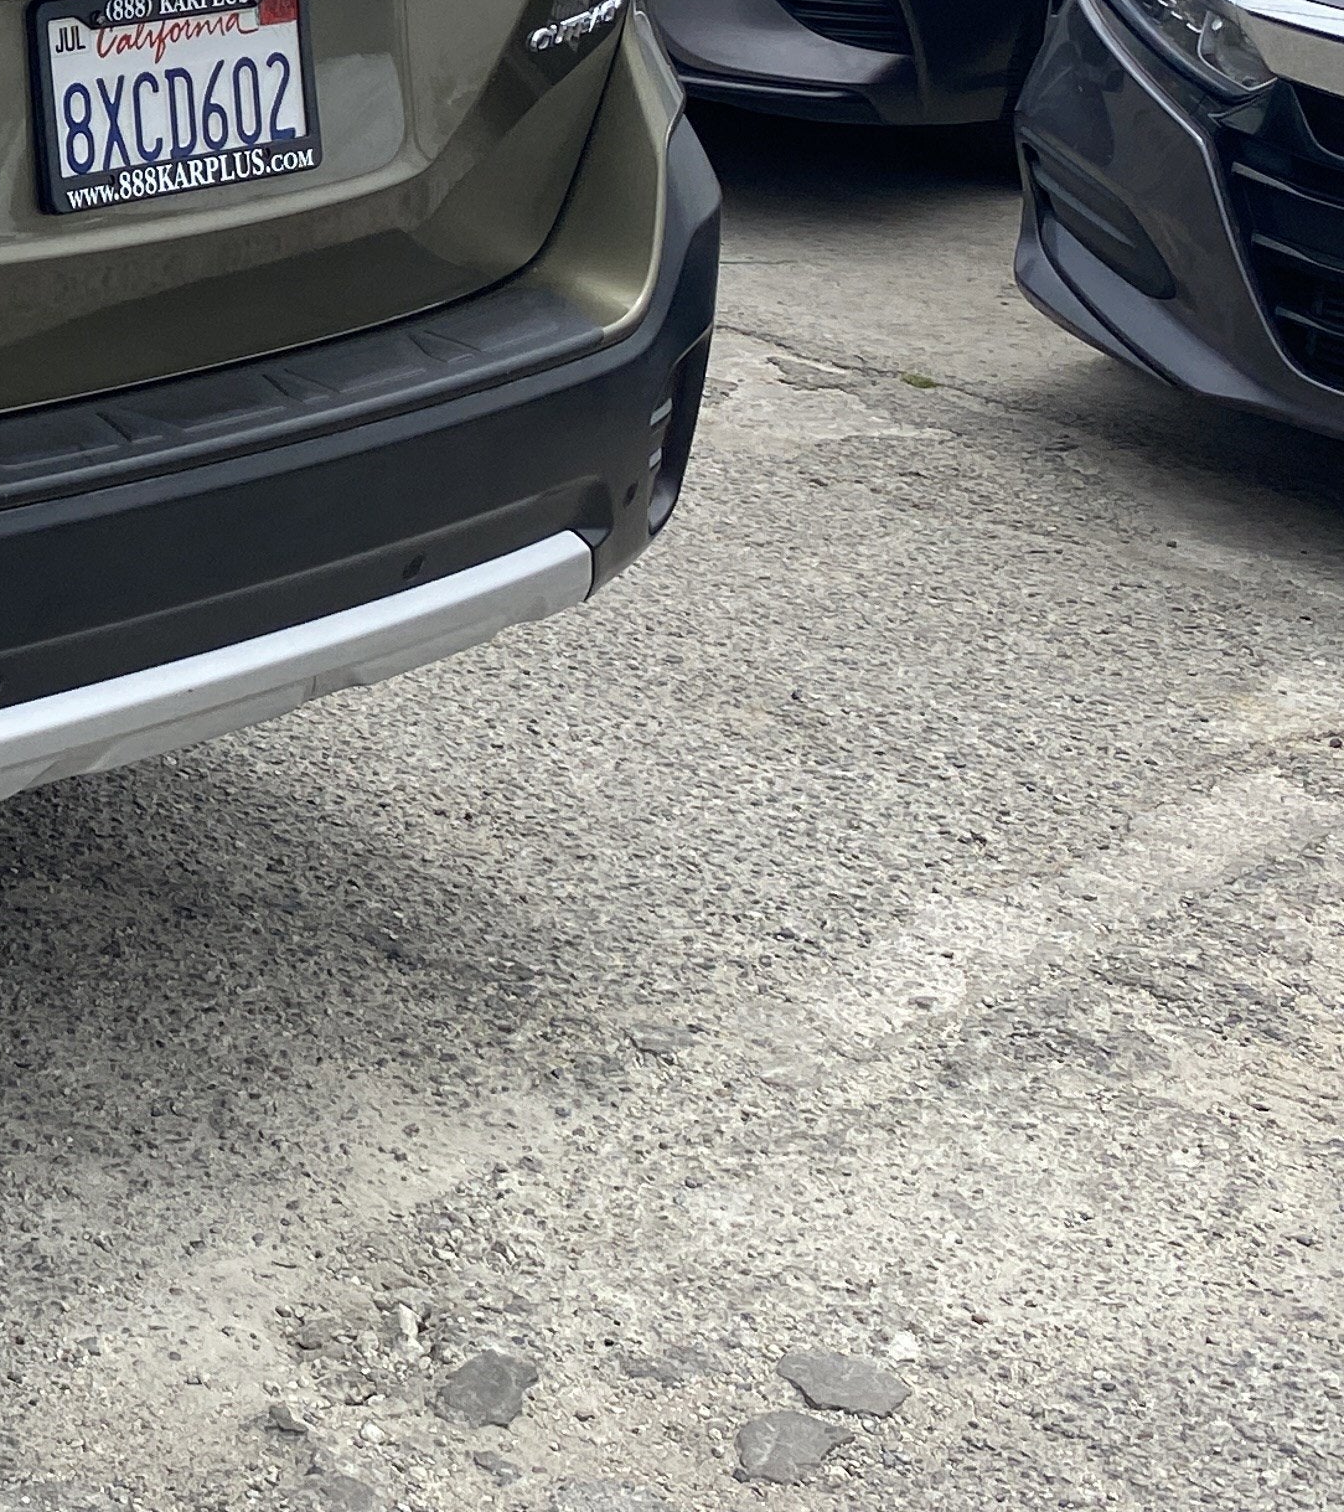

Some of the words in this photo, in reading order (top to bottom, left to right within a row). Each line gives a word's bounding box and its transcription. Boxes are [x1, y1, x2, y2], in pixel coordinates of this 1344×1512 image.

[55, 26, 86, 54] JUL
[95, 12, 259, 64] California
[63, 51, 296, 175] 8XCD602
